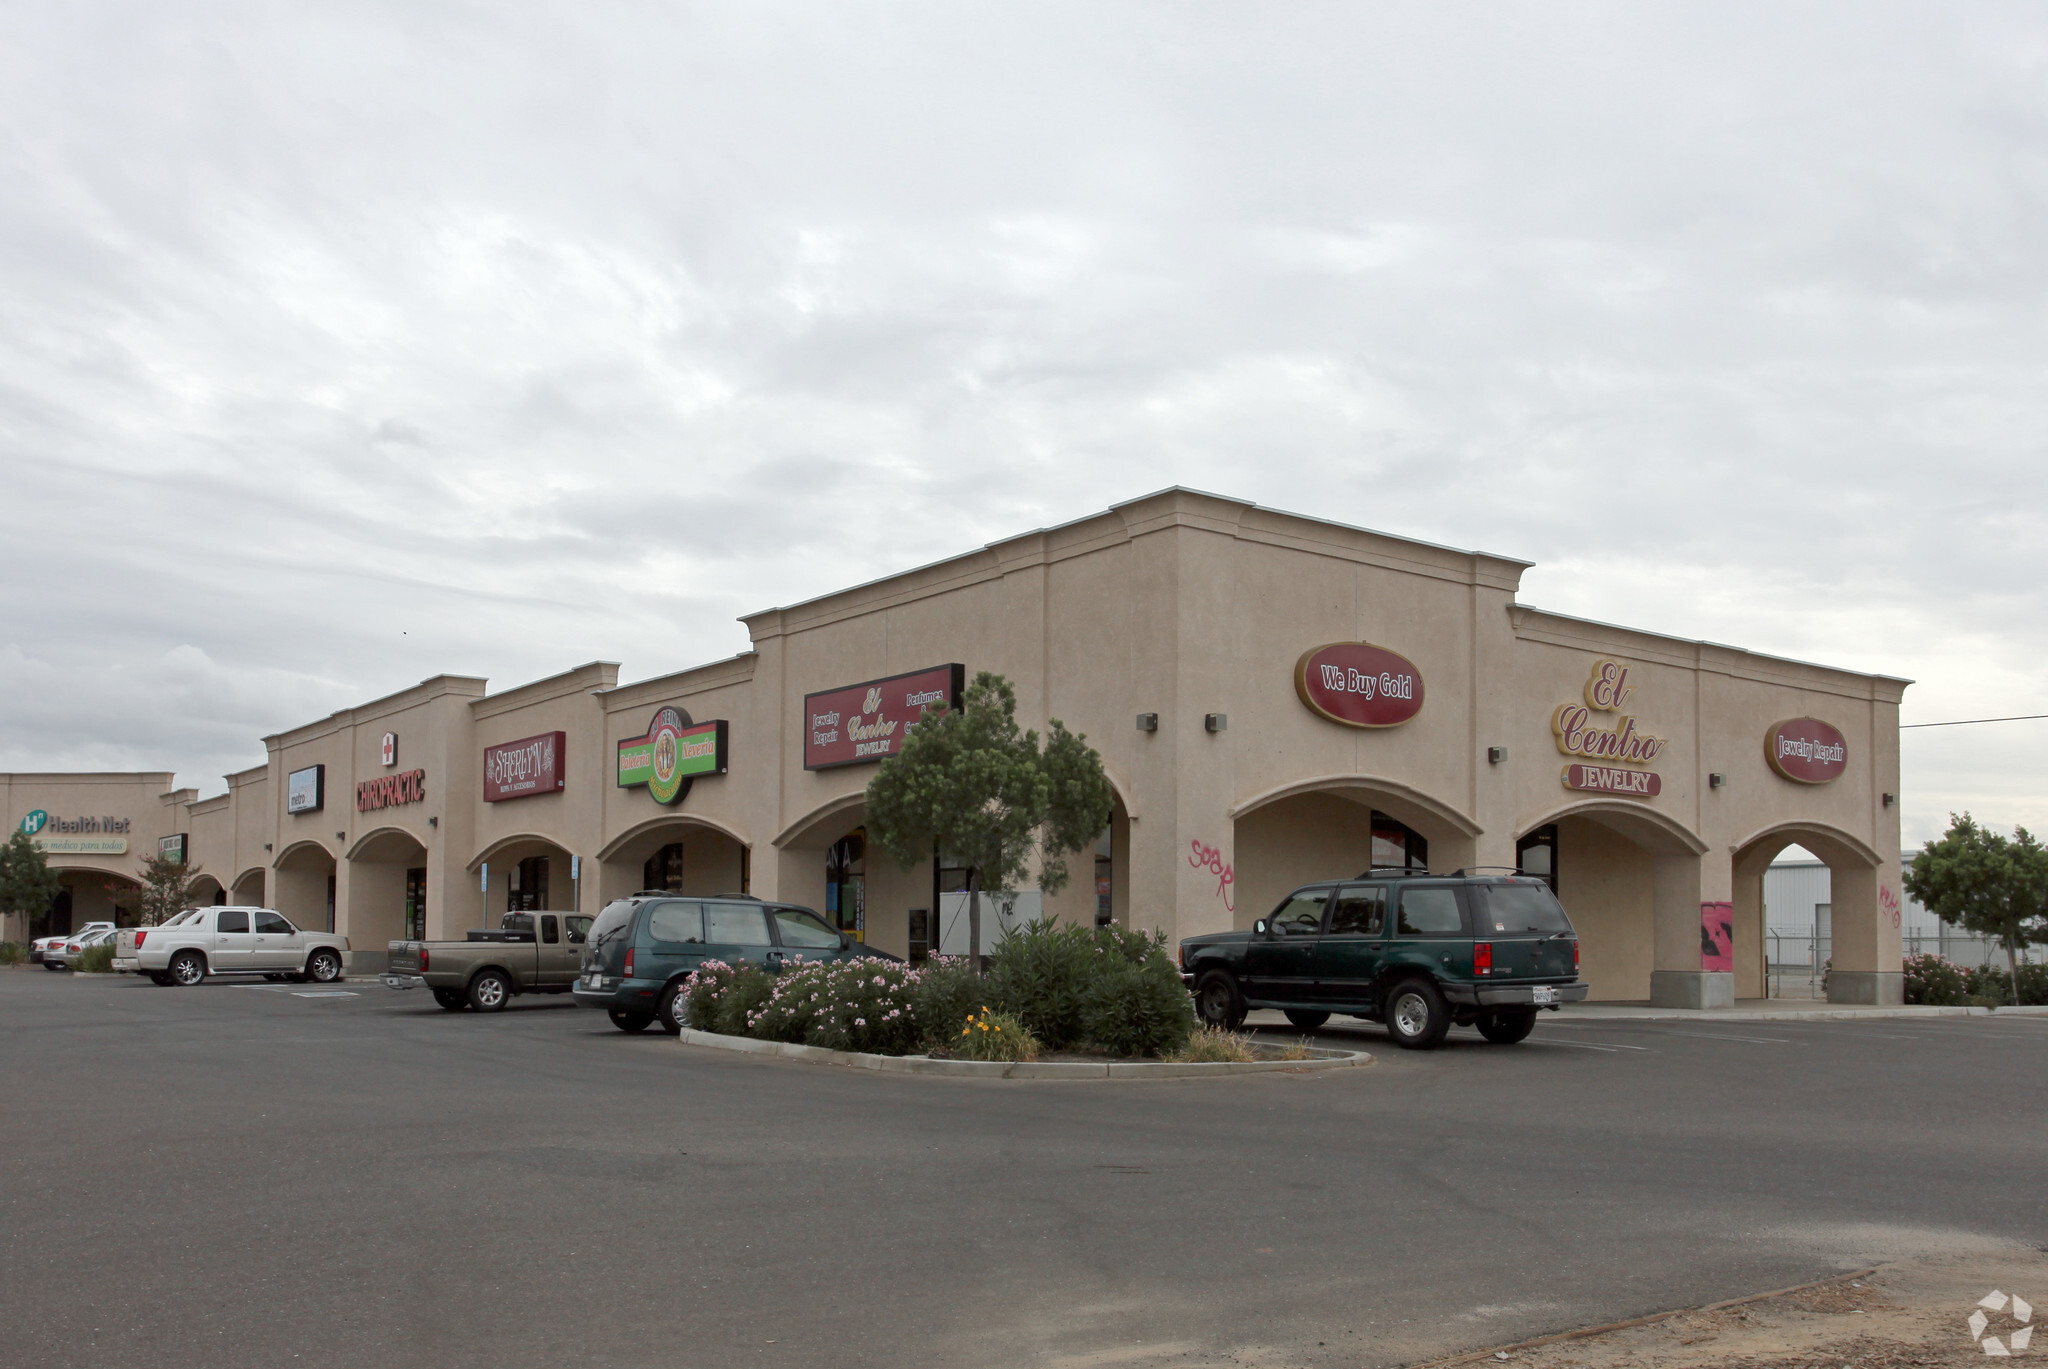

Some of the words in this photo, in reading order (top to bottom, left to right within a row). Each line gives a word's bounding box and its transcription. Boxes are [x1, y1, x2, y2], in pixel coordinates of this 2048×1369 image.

[1321, 664, 1345, 691] We
[1348, 667, 1377, 701] Buy
[1380, 672, 1412, 700] Gold
[1593, 662, 1631, 708] El
[863, 687, 882, 715] El
[907, 689, 944, 706] Perfumes
[661, 708, 682, 737] REINA
[812, 711, 840, 731] Jewelry
[848, 713, 898, 742] Centro
[1560, 705, 1664, 761] Centro
[813, 730, 838, 747] Repair
[856, 741, 891, 757] JEWELRY
[1779, 735, 1813, 762] Jewelry
[1814, 740, 1843, 765] Repair
[357, 768, 422, 813] CHIROPRACTIC
[1580, 766, 1651, 793] JEWELRY
[49, 816, 100, 833] Health
[102, 816, 130, 834] Net
[50, 838, 78, 850] médico
[80, 842, 99, 851] para
[101, 839, 123, 850] todos
